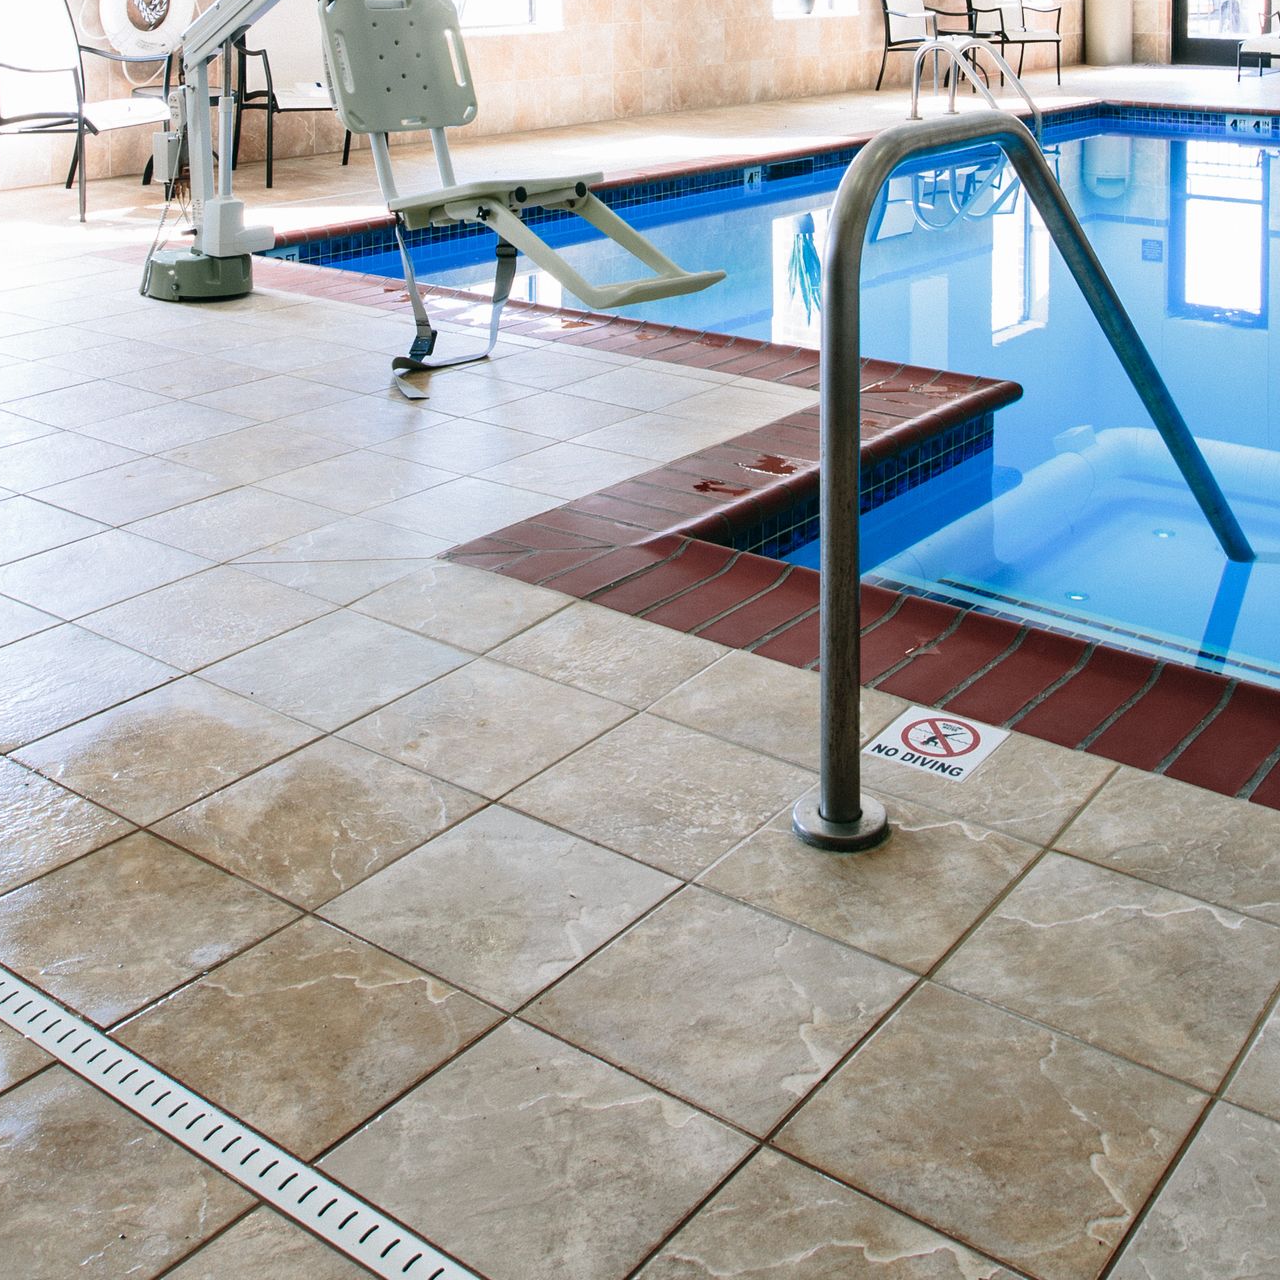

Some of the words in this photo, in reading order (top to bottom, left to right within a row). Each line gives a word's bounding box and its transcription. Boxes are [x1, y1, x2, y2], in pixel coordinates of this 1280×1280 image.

[285, 253, 296, 262] FT
[871, 743, 899, 756] NO
[900, 751, 963, 777] DIVING
